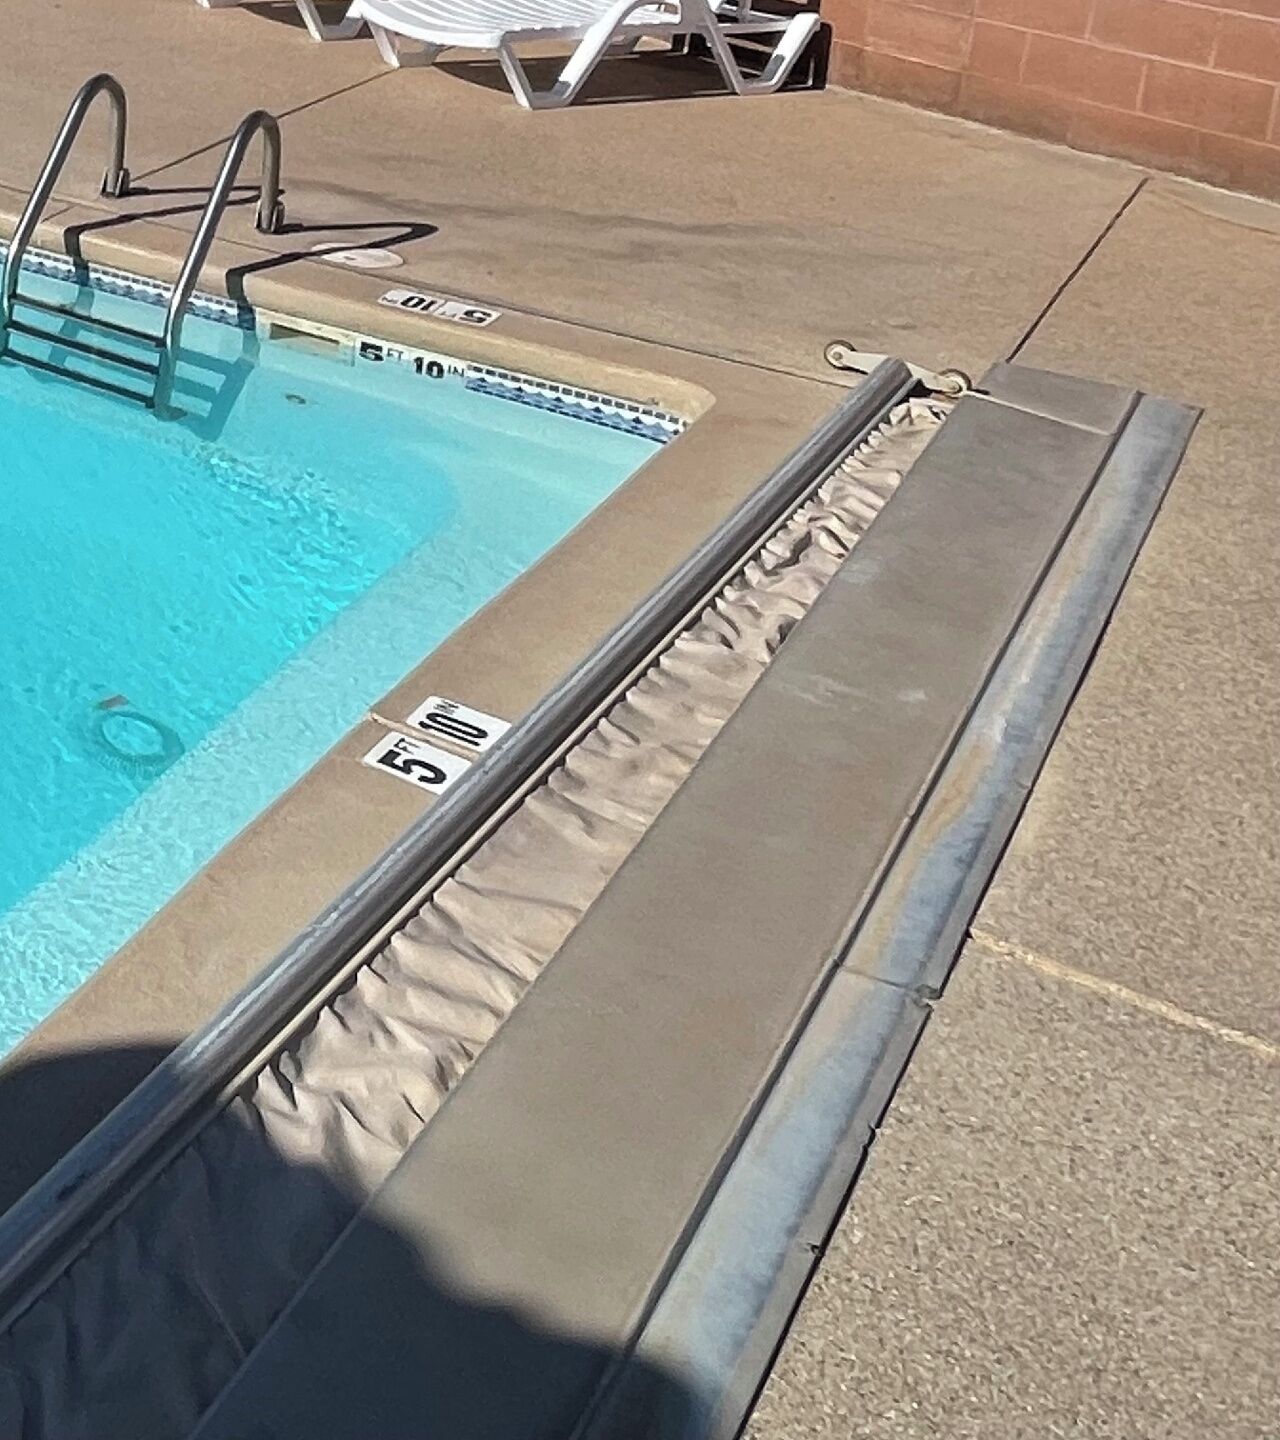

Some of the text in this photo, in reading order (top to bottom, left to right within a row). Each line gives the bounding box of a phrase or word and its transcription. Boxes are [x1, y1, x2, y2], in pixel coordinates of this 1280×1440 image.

[400, 295, 438, 310] 10
[459, 309, 493, 324] 5
[359, 341, 384, 361] 5
[414, 356, 445, 378] 10
[377, 749, 447, 785] 5
[418, 712, 488, 746] 10
